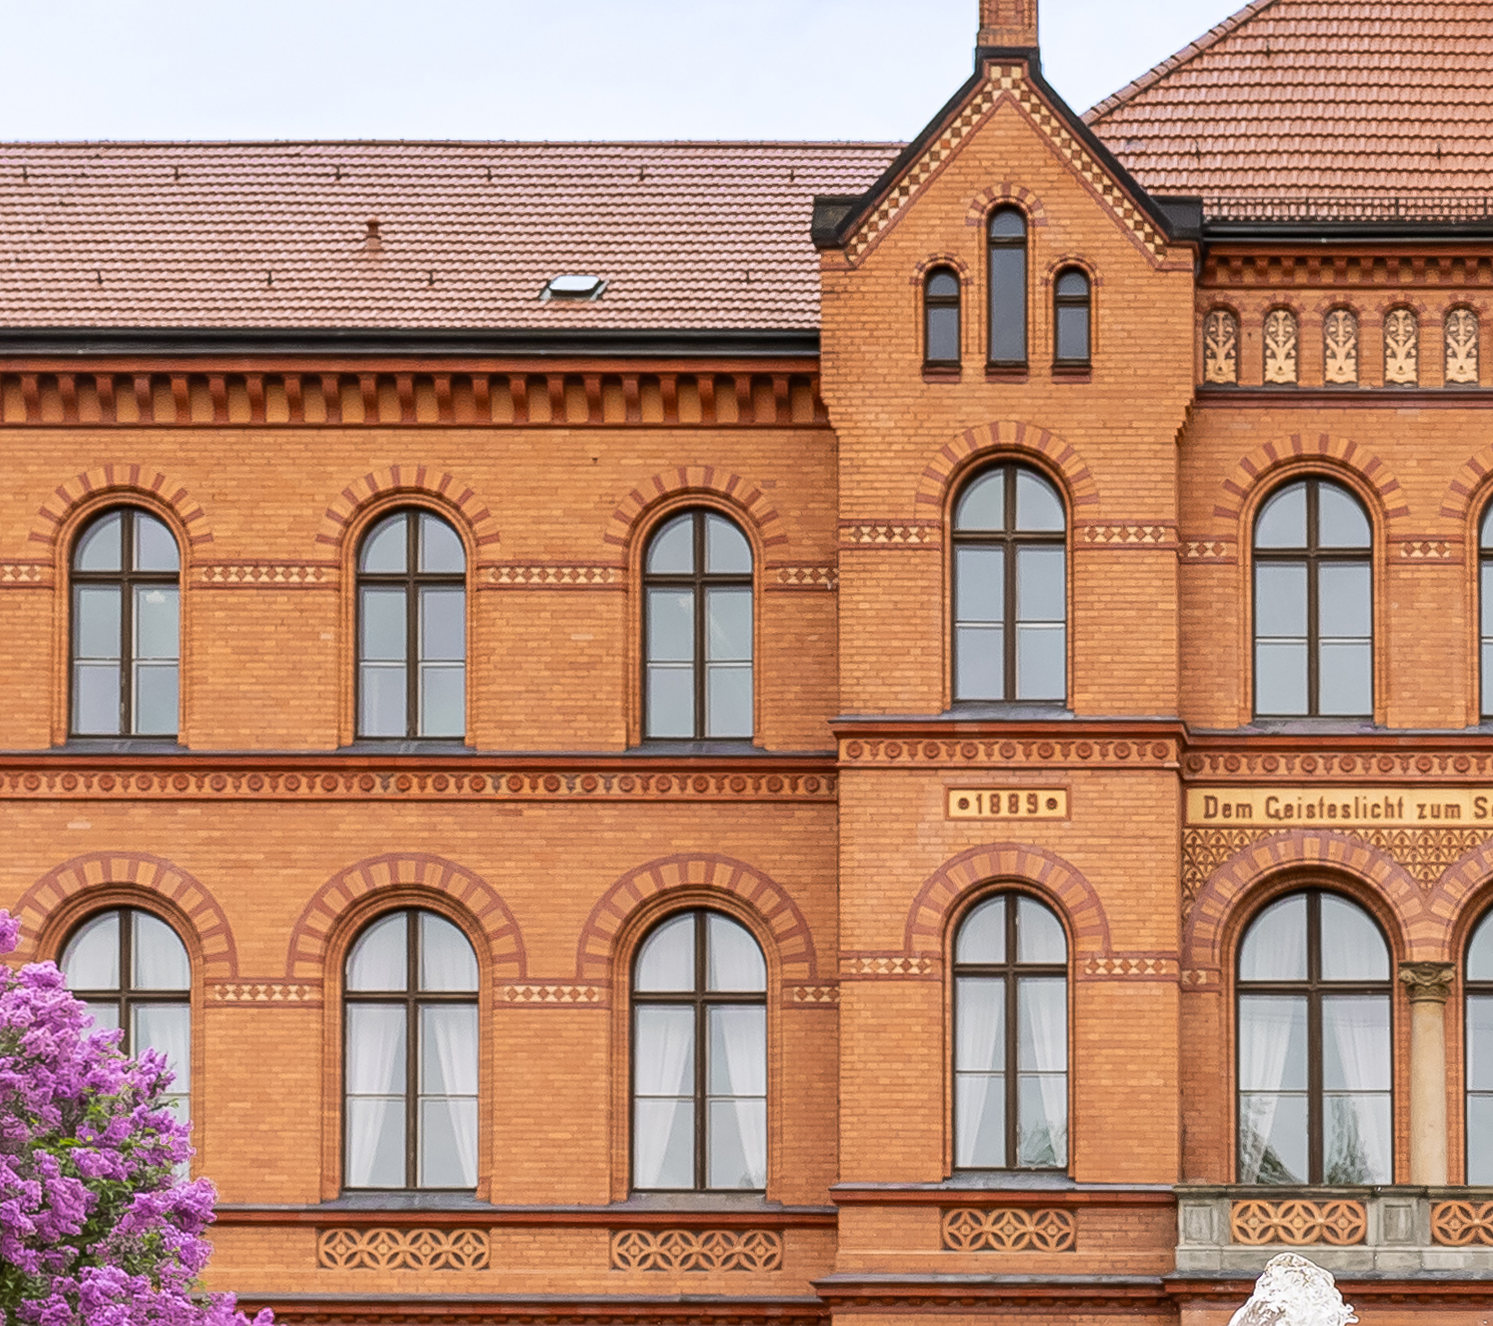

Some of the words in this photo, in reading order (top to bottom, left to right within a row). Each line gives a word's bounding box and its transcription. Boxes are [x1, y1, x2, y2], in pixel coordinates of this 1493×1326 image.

[976, 793, 1038, 815] 1889
[1203, 795, 1253, 819] Dem
[1265, 796, 1403, 820] Geisteslicht
[1417, 803, 1461, 819] zum
